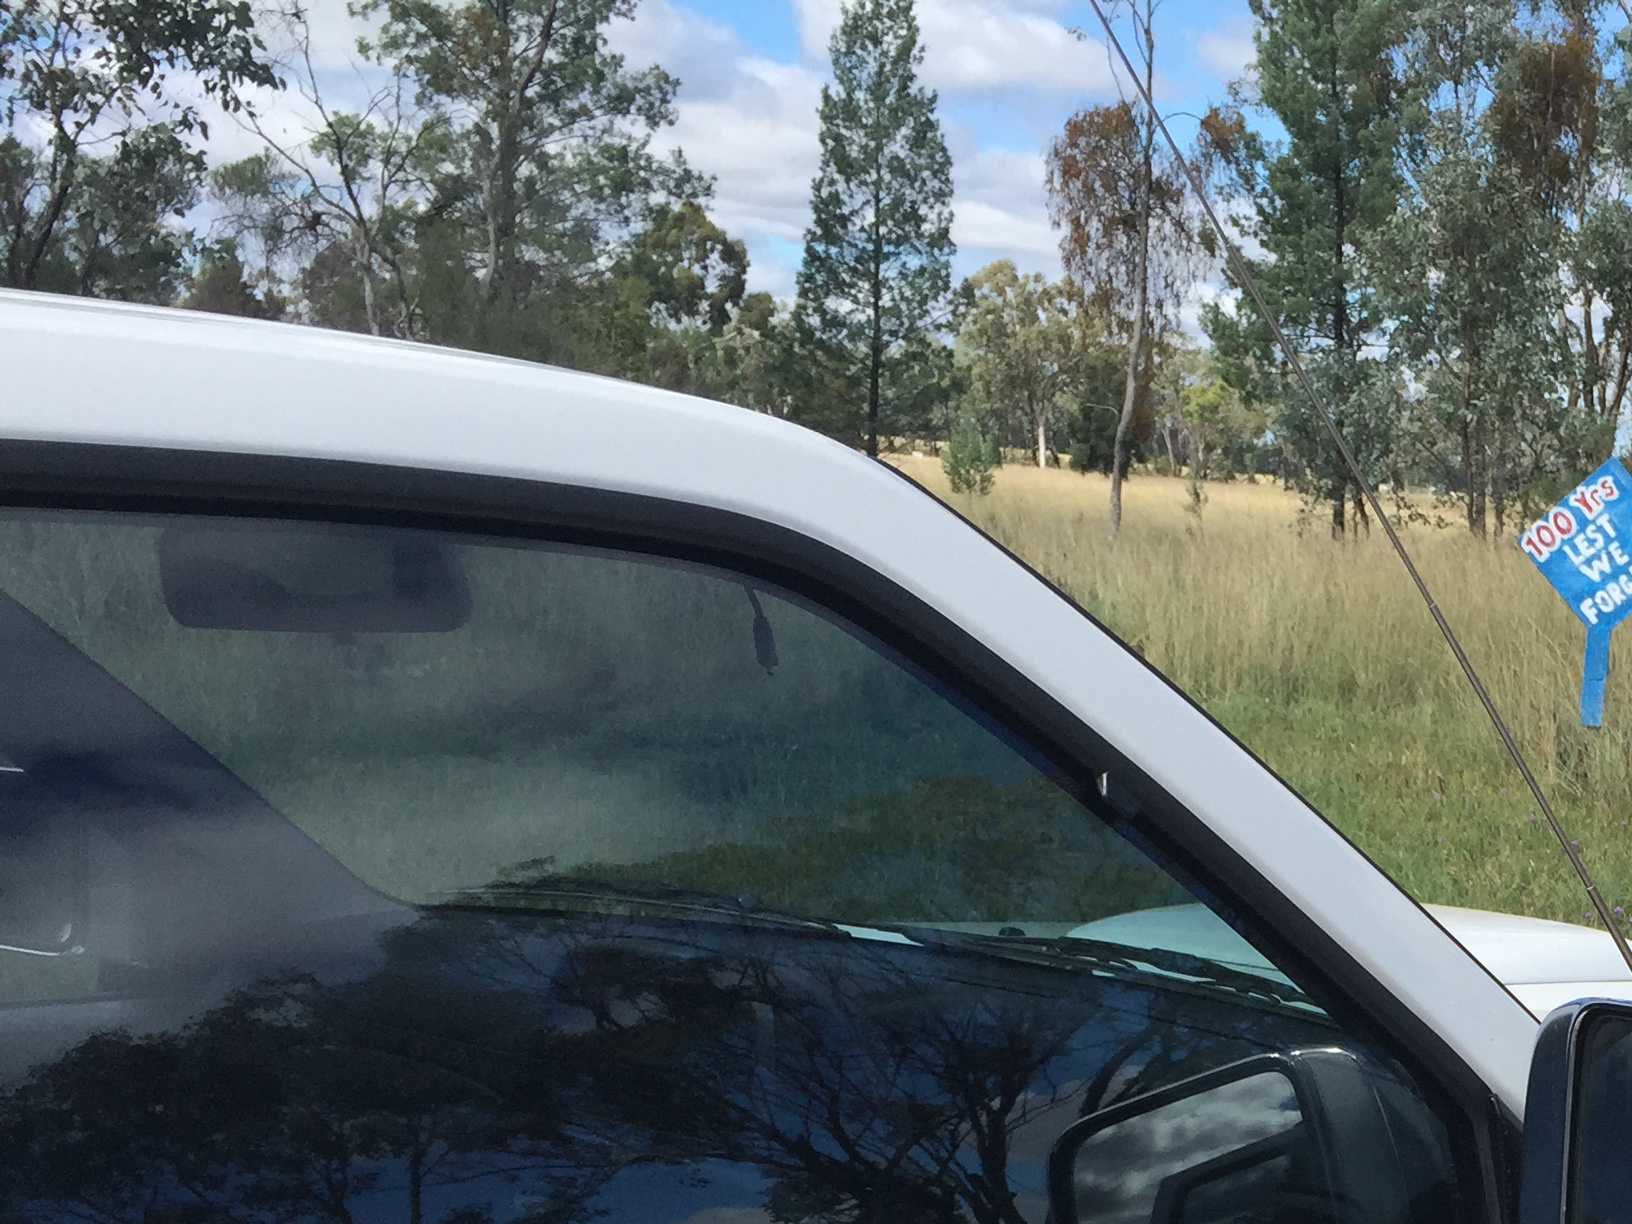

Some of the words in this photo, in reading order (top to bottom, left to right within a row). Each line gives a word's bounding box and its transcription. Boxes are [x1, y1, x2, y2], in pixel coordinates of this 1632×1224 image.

[1522, 507, 1576, 561] 100
[1570, 477, 1618, 518] Yrs
[1563, 513, 1618, 566] LEST
[1579, 541, 1630, 583] WE
